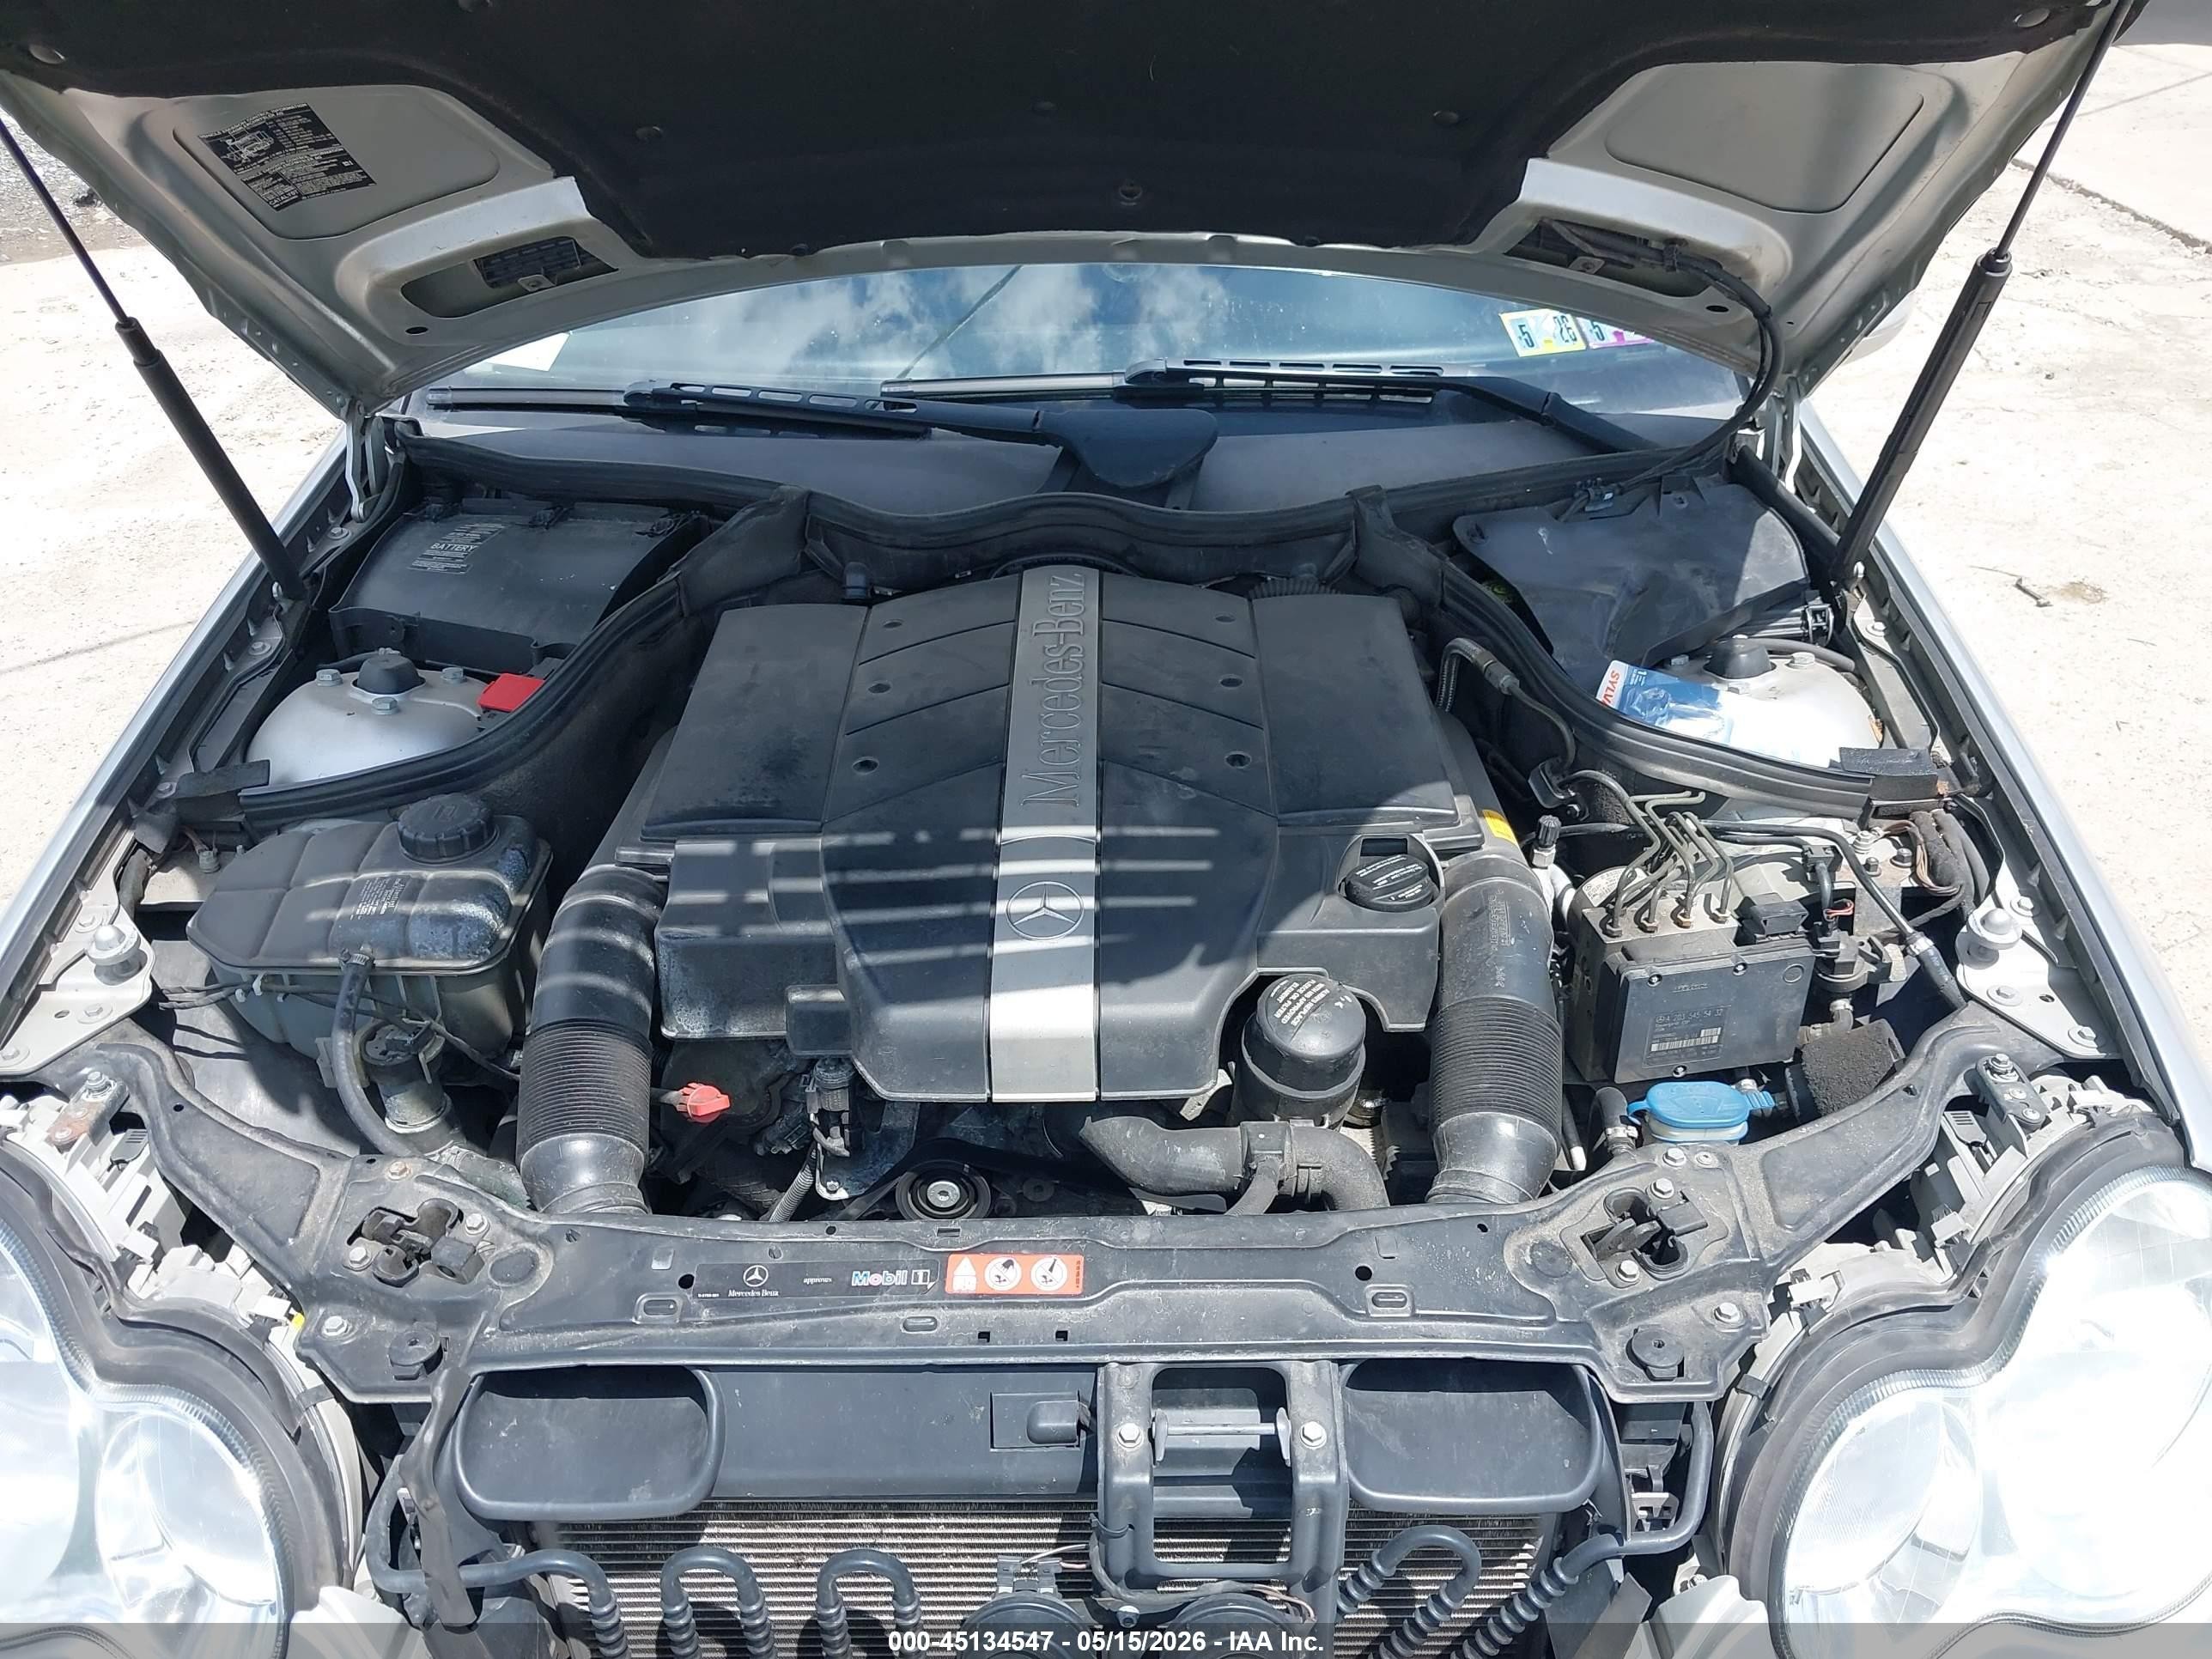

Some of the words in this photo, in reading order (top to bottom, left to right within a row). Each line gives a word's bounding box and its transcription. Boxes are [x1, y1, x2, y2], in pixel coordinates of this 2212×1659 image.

[269, 189, 300, 206] CATALYST
[430, 543, 479, 551] BATTERY
[1021, 573, 1085, 808] Mercedes-Benz
[1277, 981, 1300, 1003] ELEMENT
[1273, 1000, 1292, 1018] FILTER
[1281, 996, 1307, 1024] APPROVED
[1291, 1001, 1314, 1026] REPLACE
[851, 1269, 908, 1286] Mobil
[914, 1270, 928, 1285] 1
